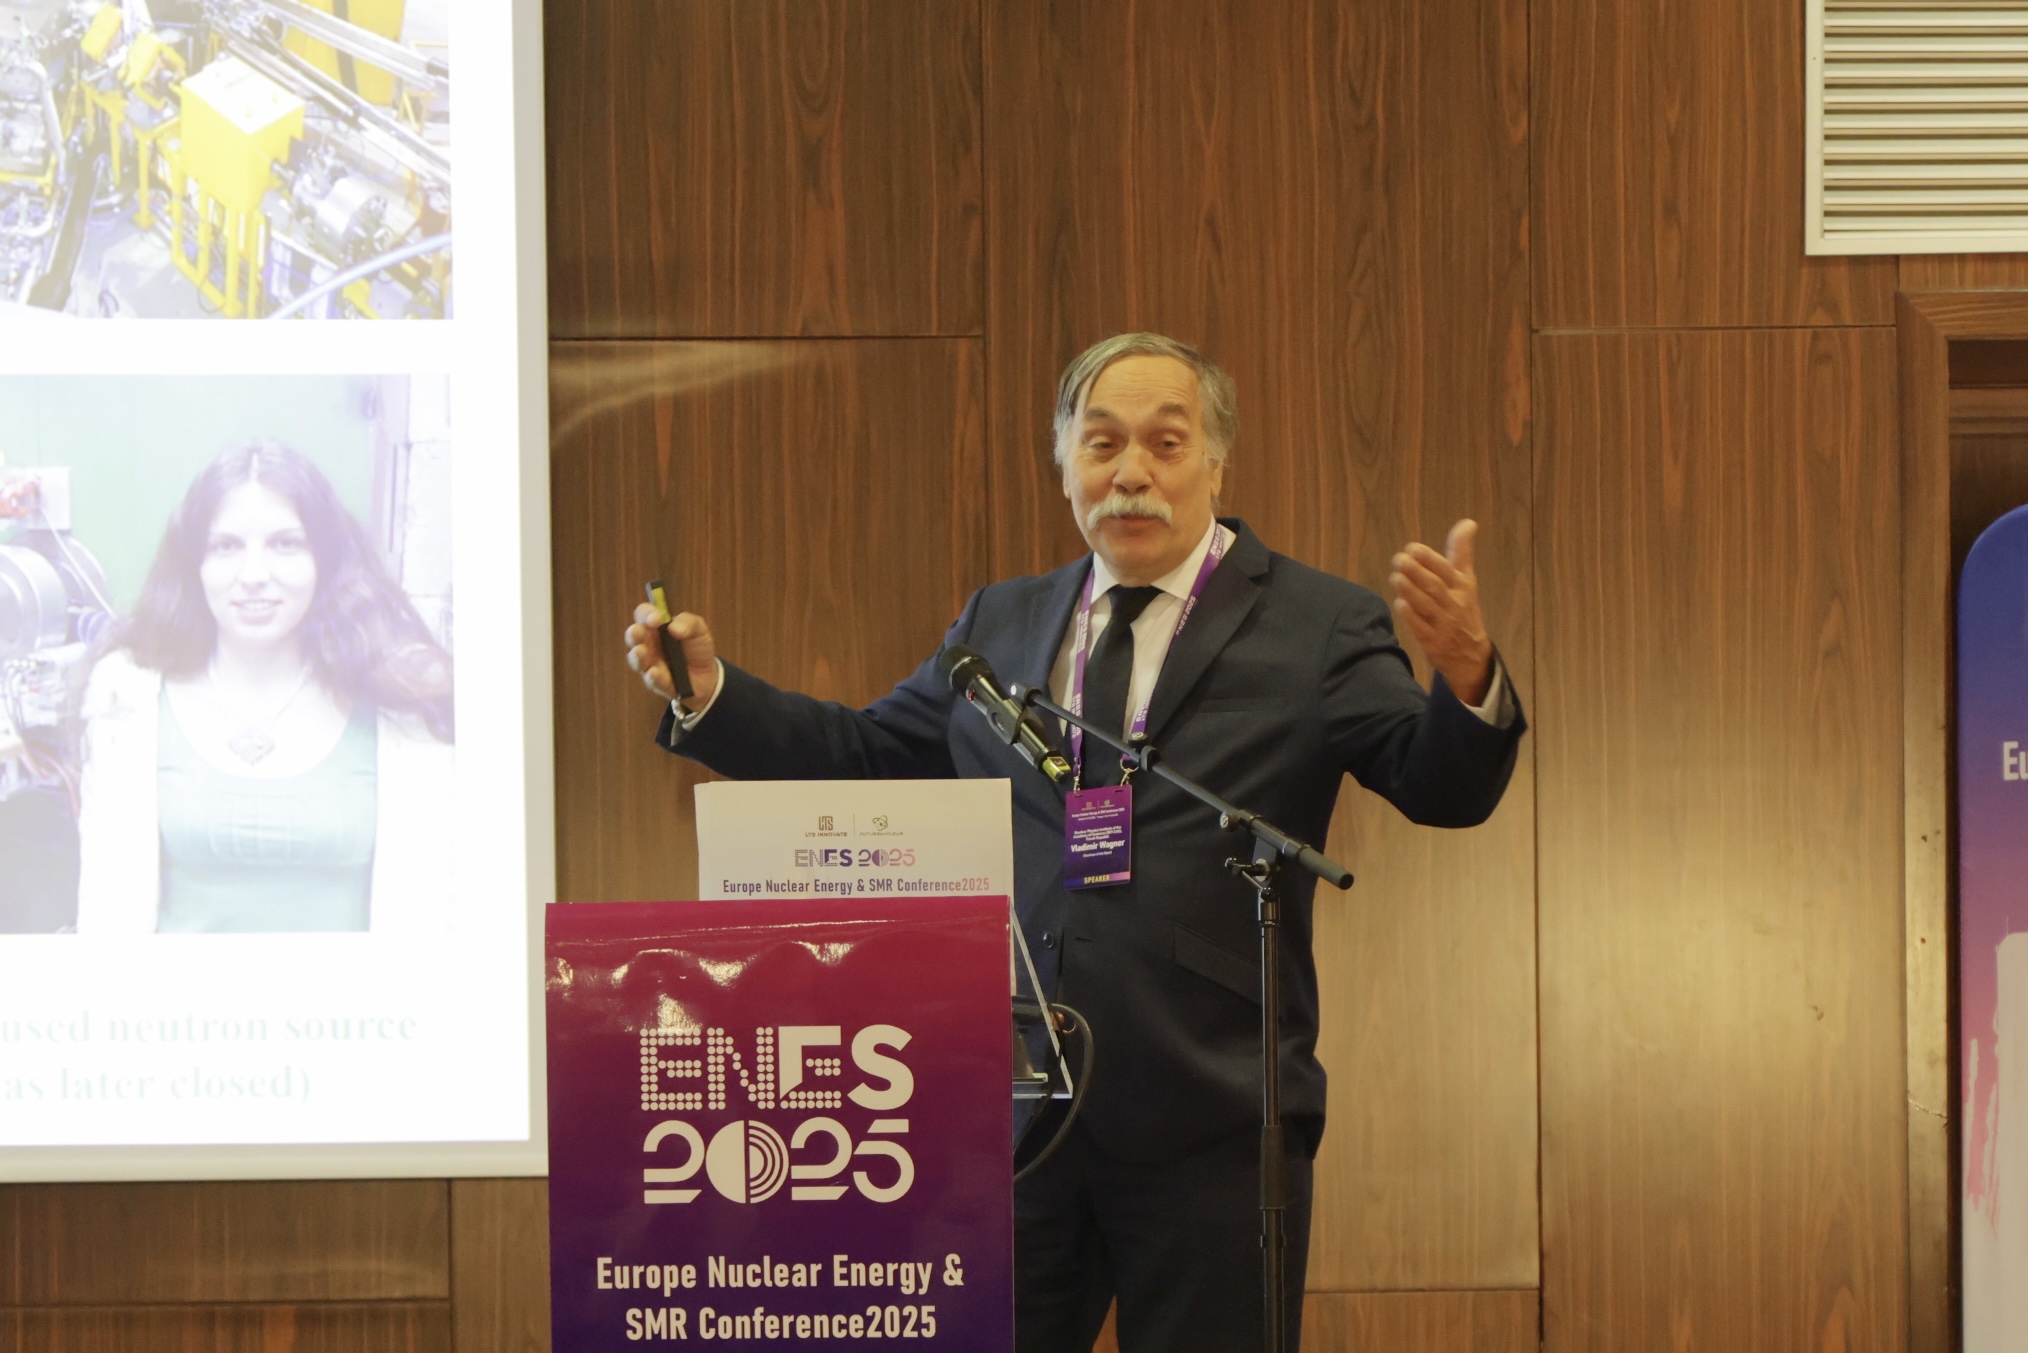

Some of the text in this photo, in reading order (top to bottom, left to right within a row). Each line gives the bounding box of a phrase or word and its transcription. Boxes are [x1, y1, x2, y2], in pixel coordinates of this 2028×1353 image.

[795, 848, 916, 867] ENES 2025
[1099, 840, 1126, 850] Wagner
[723, 878, 990, 896] Europe Nuclear Energy & SMR Conference2025
[1084, 875, 1110, 884] SPEAKER
[109, 1013, 268, 1042] neutron
[285, 1016, 417, 1040] source
[640, 1024, 914, 1111] ENES
[60, 1067, 155, 1100] later
[170, 1065, 311, 1105] closed)
[643, 1117, 915, 1204] 2025
[597, 1253, 964, 1297] Europe Nuclear Energy &
[625, 1305, 937, 1341] SMR Conference2025
